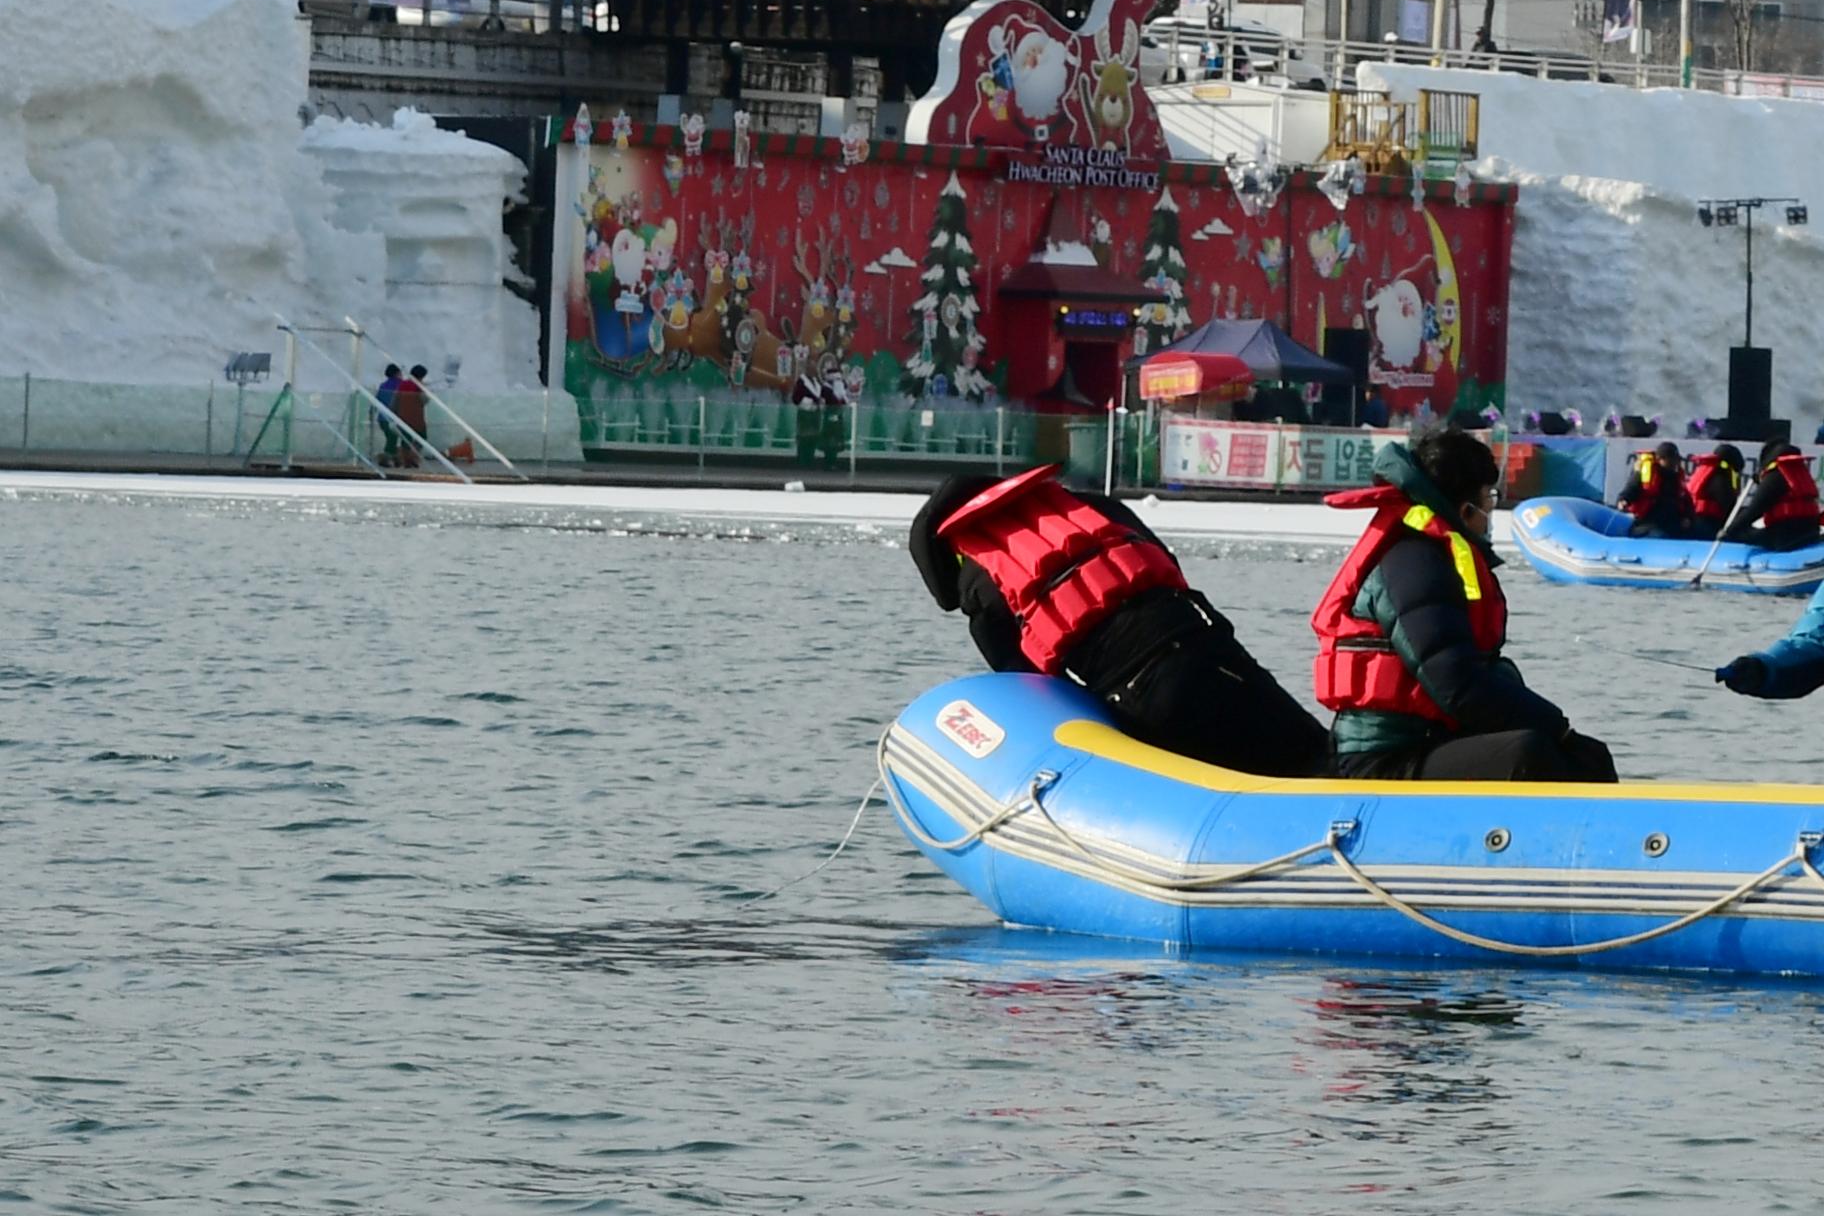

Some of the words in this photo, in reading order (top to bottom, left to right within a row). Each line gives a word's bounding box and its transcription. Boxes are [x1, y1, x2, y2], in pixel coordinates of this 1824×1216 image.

[1046, 142, 1085, 166] SANTA
[1086, 147, 1126, 167] CLAUS
[1008, 160, 1083, 185] HWACHEON
[1085, 166, 1116, 186] POST
[1117, 169, 1160, 191] OFFICE
